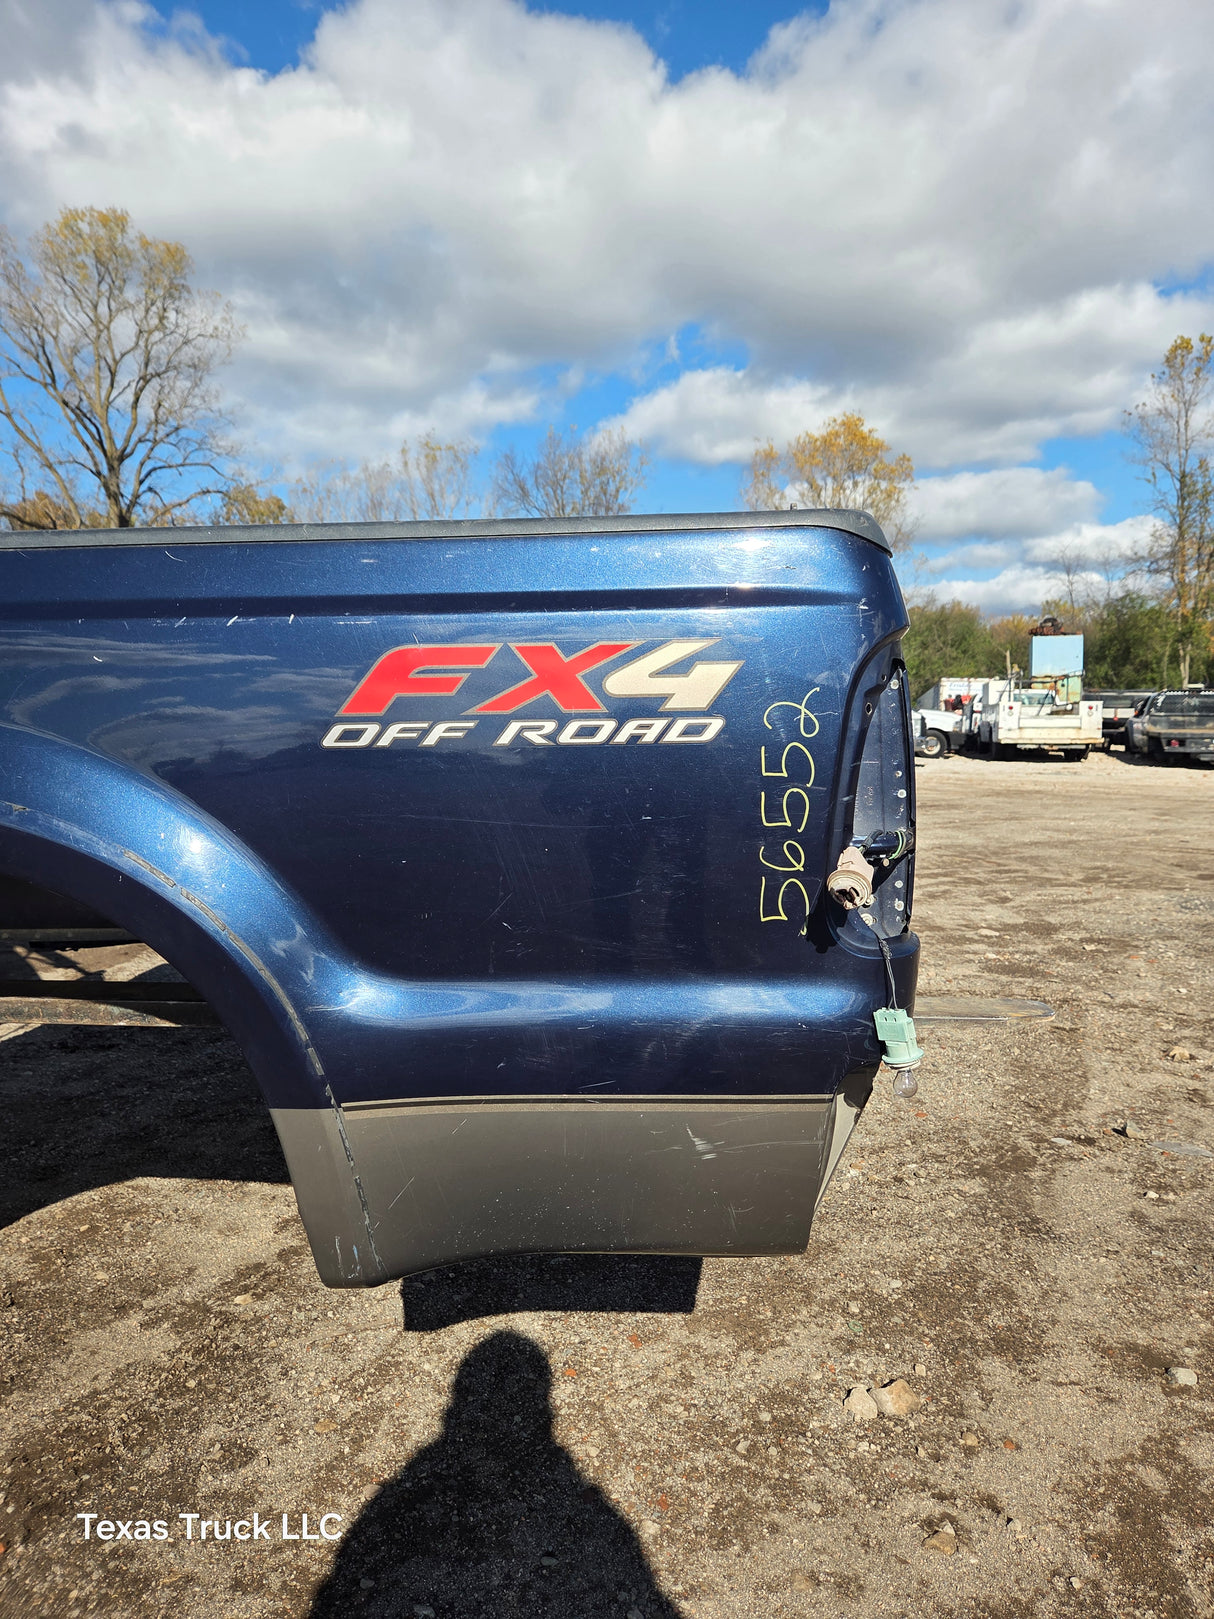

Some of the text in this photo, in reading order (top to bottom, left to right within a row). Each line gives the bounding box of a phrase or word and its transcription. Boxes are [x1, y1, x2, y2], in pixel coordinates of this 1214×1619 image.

[336, 638, 745, 716] FX4
[321, 716, 726, 749] OFF ROAD
[760, 687, 821, 936] 56552
